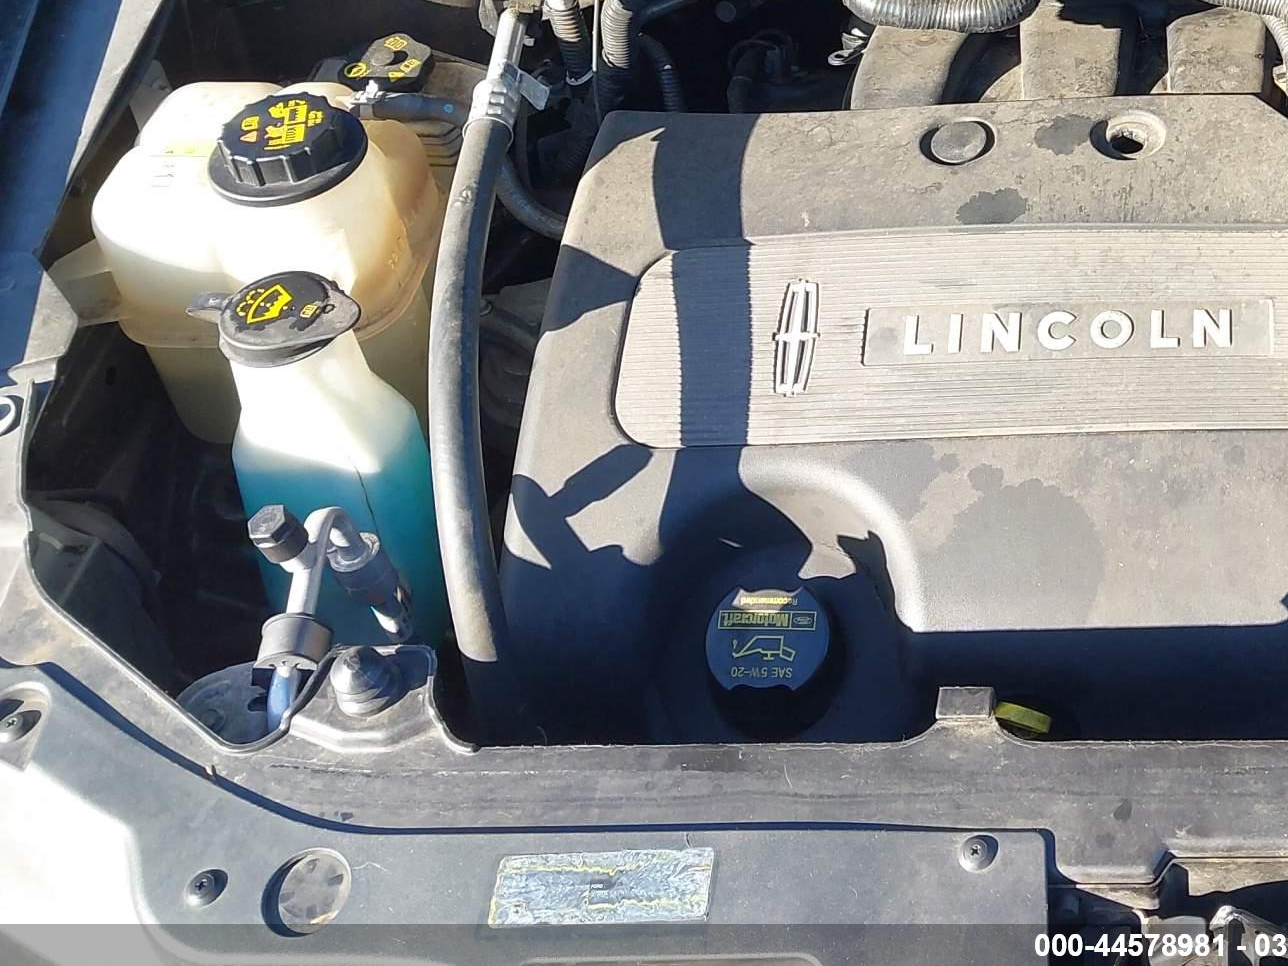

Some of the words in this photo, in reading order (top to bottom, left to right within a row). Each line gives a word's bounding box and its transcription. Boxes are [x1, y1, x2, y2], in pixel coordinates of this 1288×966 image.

[903, 308, 1233, 355] LINCOLN
[722, 613, 789, 627] Motorcraft
[730, 666, 768, 678] 5W-20
[770, 667, 793, 678] SAE
